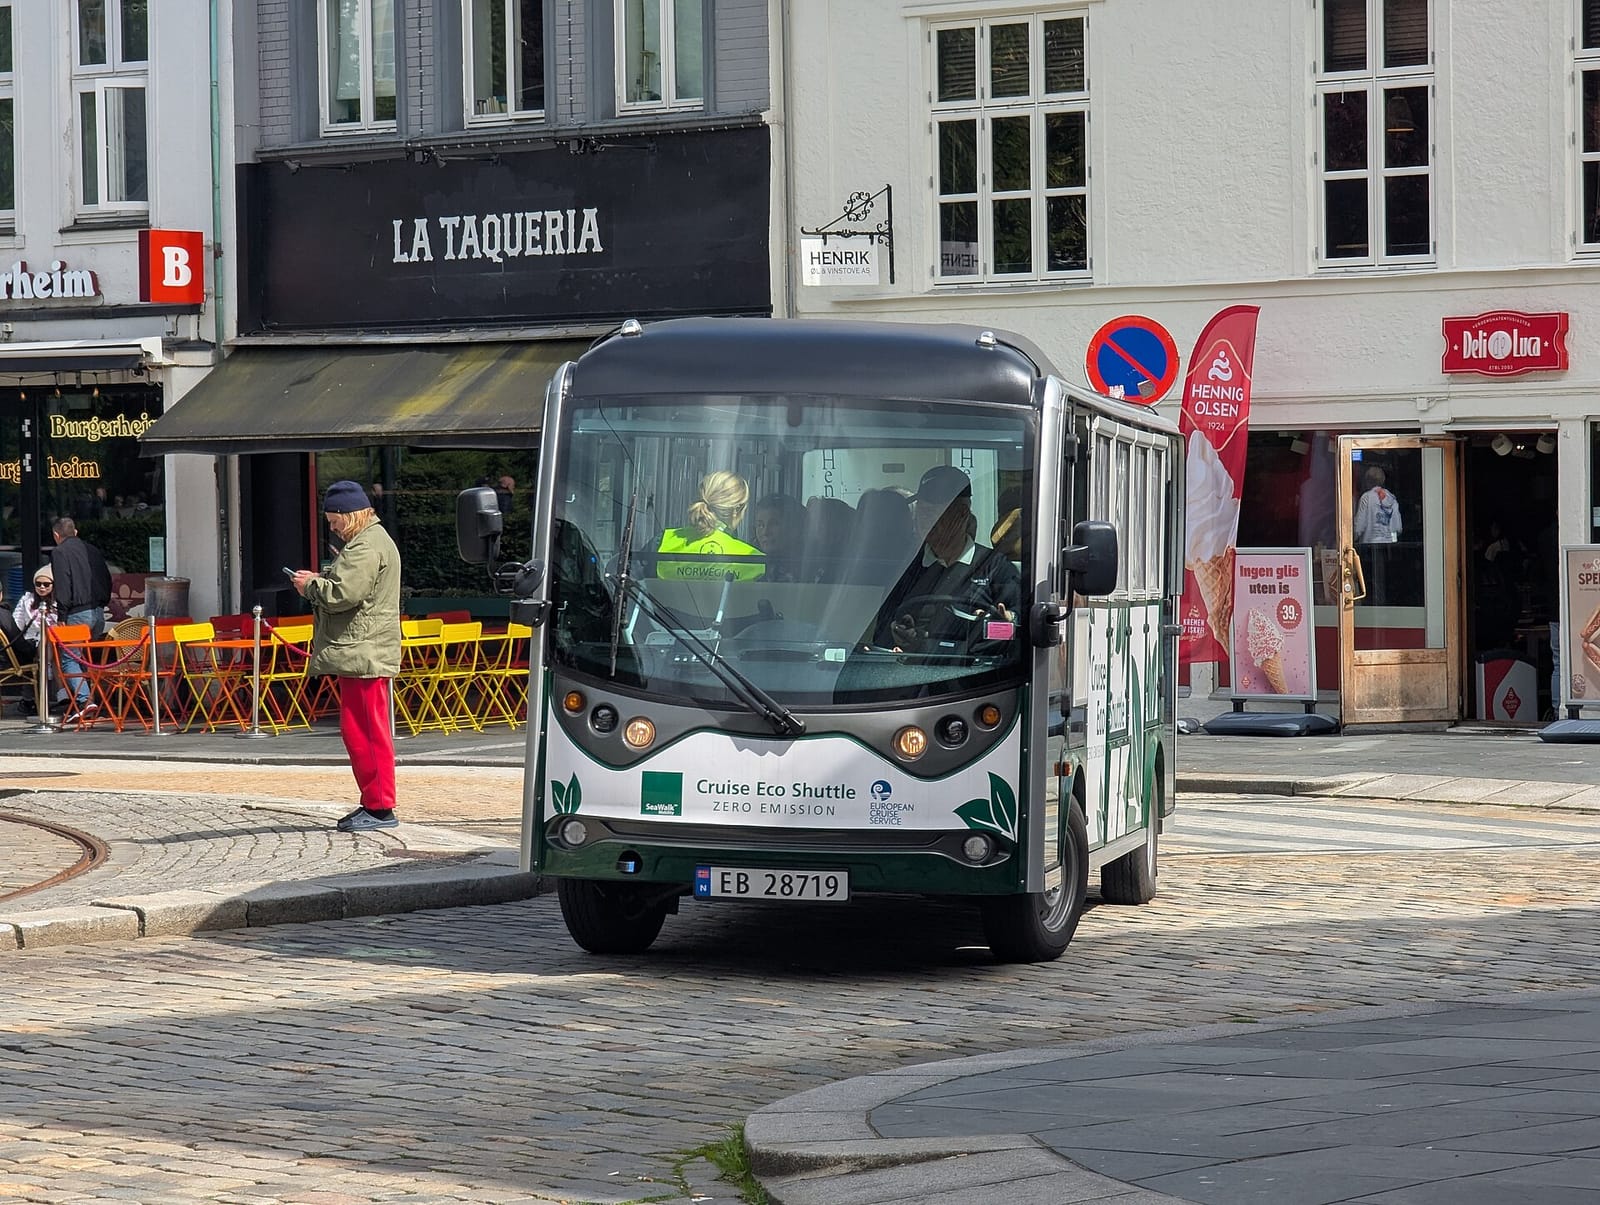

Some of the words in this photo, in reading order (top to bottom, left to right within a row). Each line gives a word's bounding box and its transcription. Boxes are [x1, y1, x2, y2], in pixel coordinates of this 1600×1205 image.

[392, 218, 434, 263] LA
[439, 207, 603, 263] TAQUERIA
[810, 251, 870, 265] HENRIK
[162, 246, 193, 287] B
[861, 267, 871, 275] AS
[1462, 329, 1488, 360] Deli
[1512, 328, 1541, 358] Luca
[1191, 383, 1244, 401] HENNIG
[1194, 401, 1239, 417] OLSEN
[50, 412, 158, 442] Burgerhei
[1207, 421, 1225, 431] 1924
[676, 566, 740, 580] NORWEGIN
[1239, 565, 1274, 580] Ingen
[1276, 564, 1299, 580] glis
[1578, 572, 1600, 586] SPE
[1249, 582, 1276, 595] uten
[1278, 581, 1290, 595] is
[696, 779, 751, 796] Cruise
[756, 781, 787, 798] Eco
[792, 782, 857, 800] Shuttle
[712, 801, 752, 813] ZERO
[760, 803, 836, 816] EMISSION
[870, 802, 915, 811] EUROPEAN
[869, 810, 899, 818] CRUISE
[869, 817, 902, 826] SERVICE
[699, 884, 707, 892] N
[720, 871, 750, 895] EB
[764, 873, 839, 898] 28719
